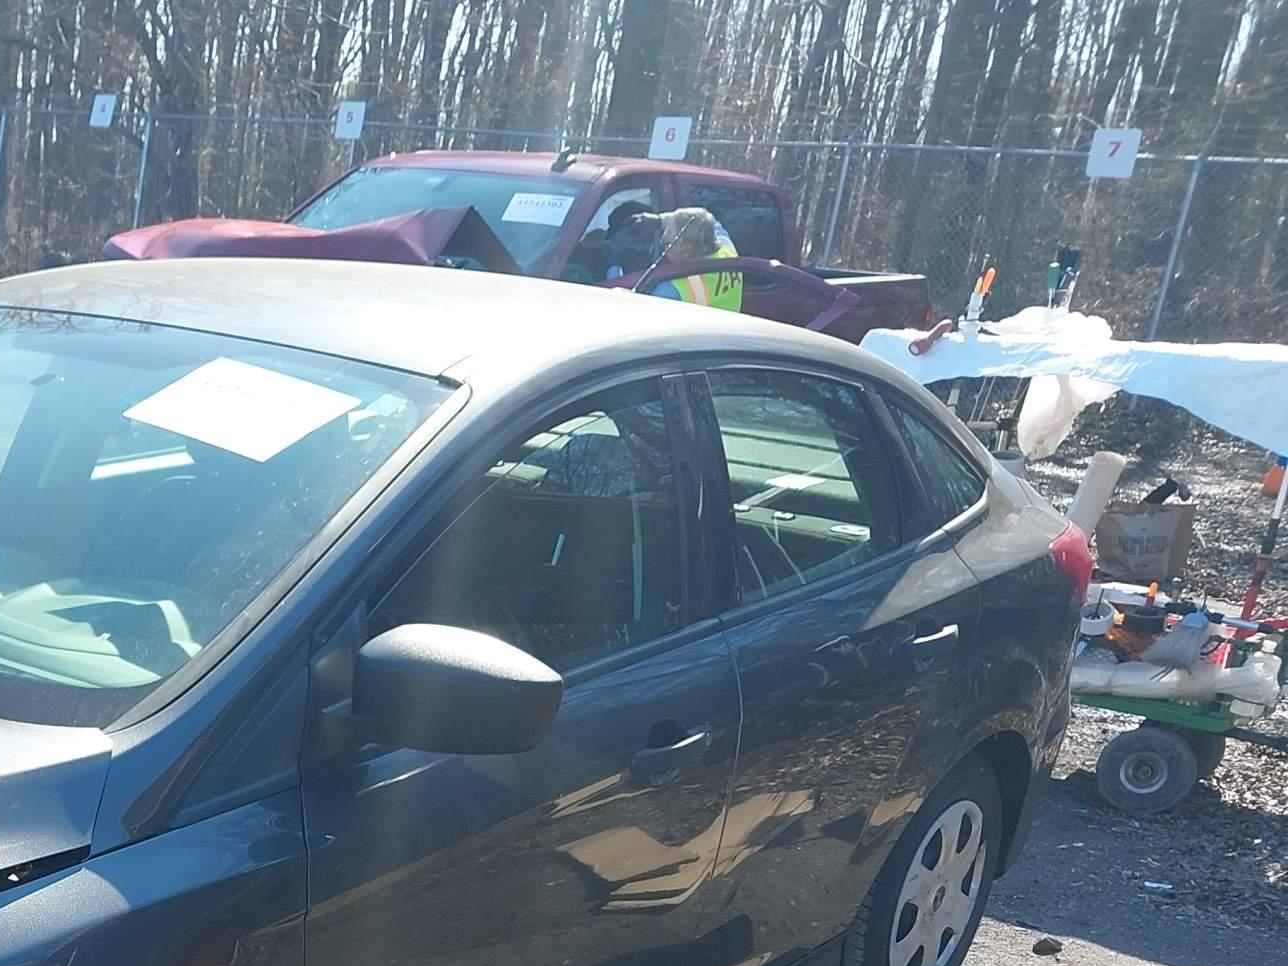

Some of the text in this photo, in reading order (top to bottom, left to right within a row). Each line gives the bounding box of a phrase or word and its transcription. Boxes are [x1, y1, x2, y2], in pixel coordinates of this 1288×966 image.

[345, 111, 354, 124] 5
[664, 127, 677, 143] 6
[1107, 140, 1123, 159] 7
